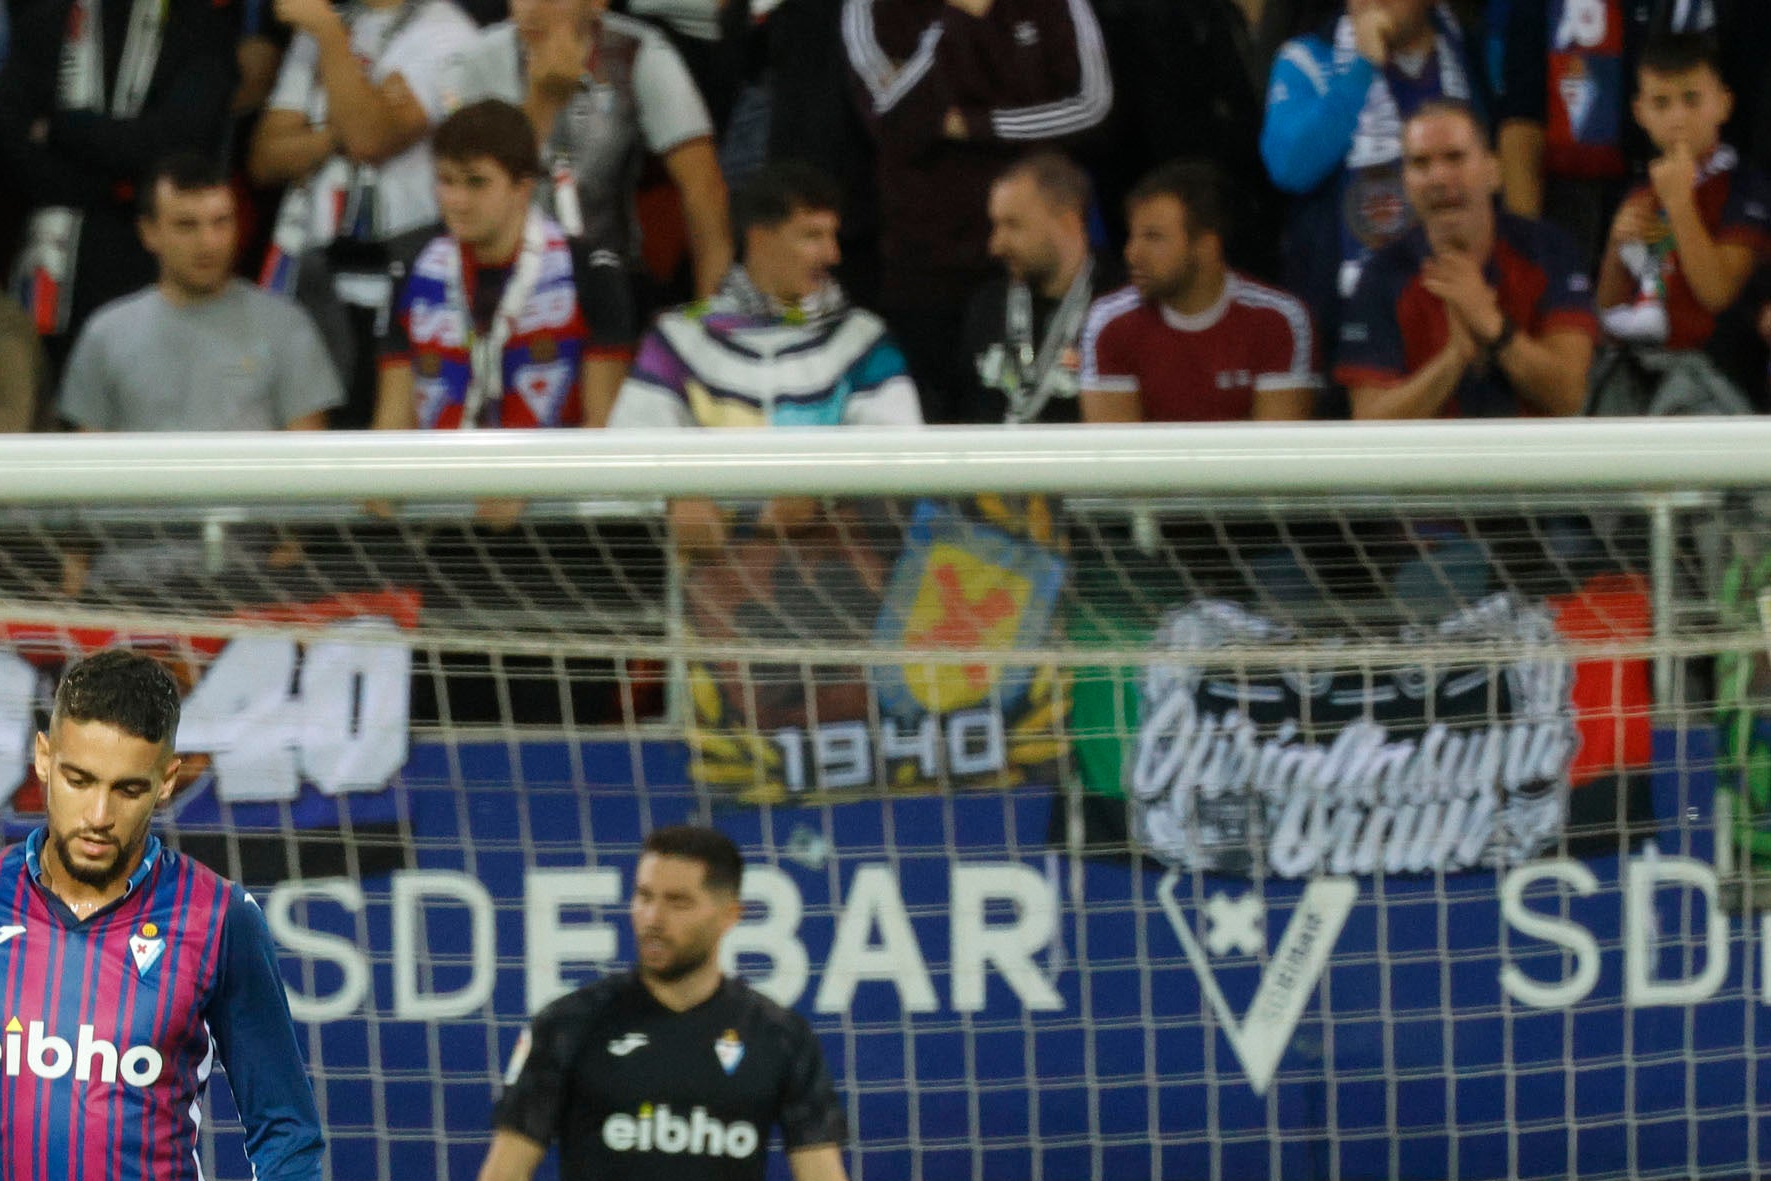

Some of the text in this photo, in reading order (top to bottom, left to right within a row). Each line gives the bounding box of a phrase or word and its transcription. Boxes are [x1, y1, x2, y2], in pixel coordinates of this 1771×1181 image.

[776, 710, 1005, 792] 1940
[525, 862, 1066, 1013] EBAR
[1499, 856, 1728, 1007] SD
[602, 1102, 759, 1160] eibho
